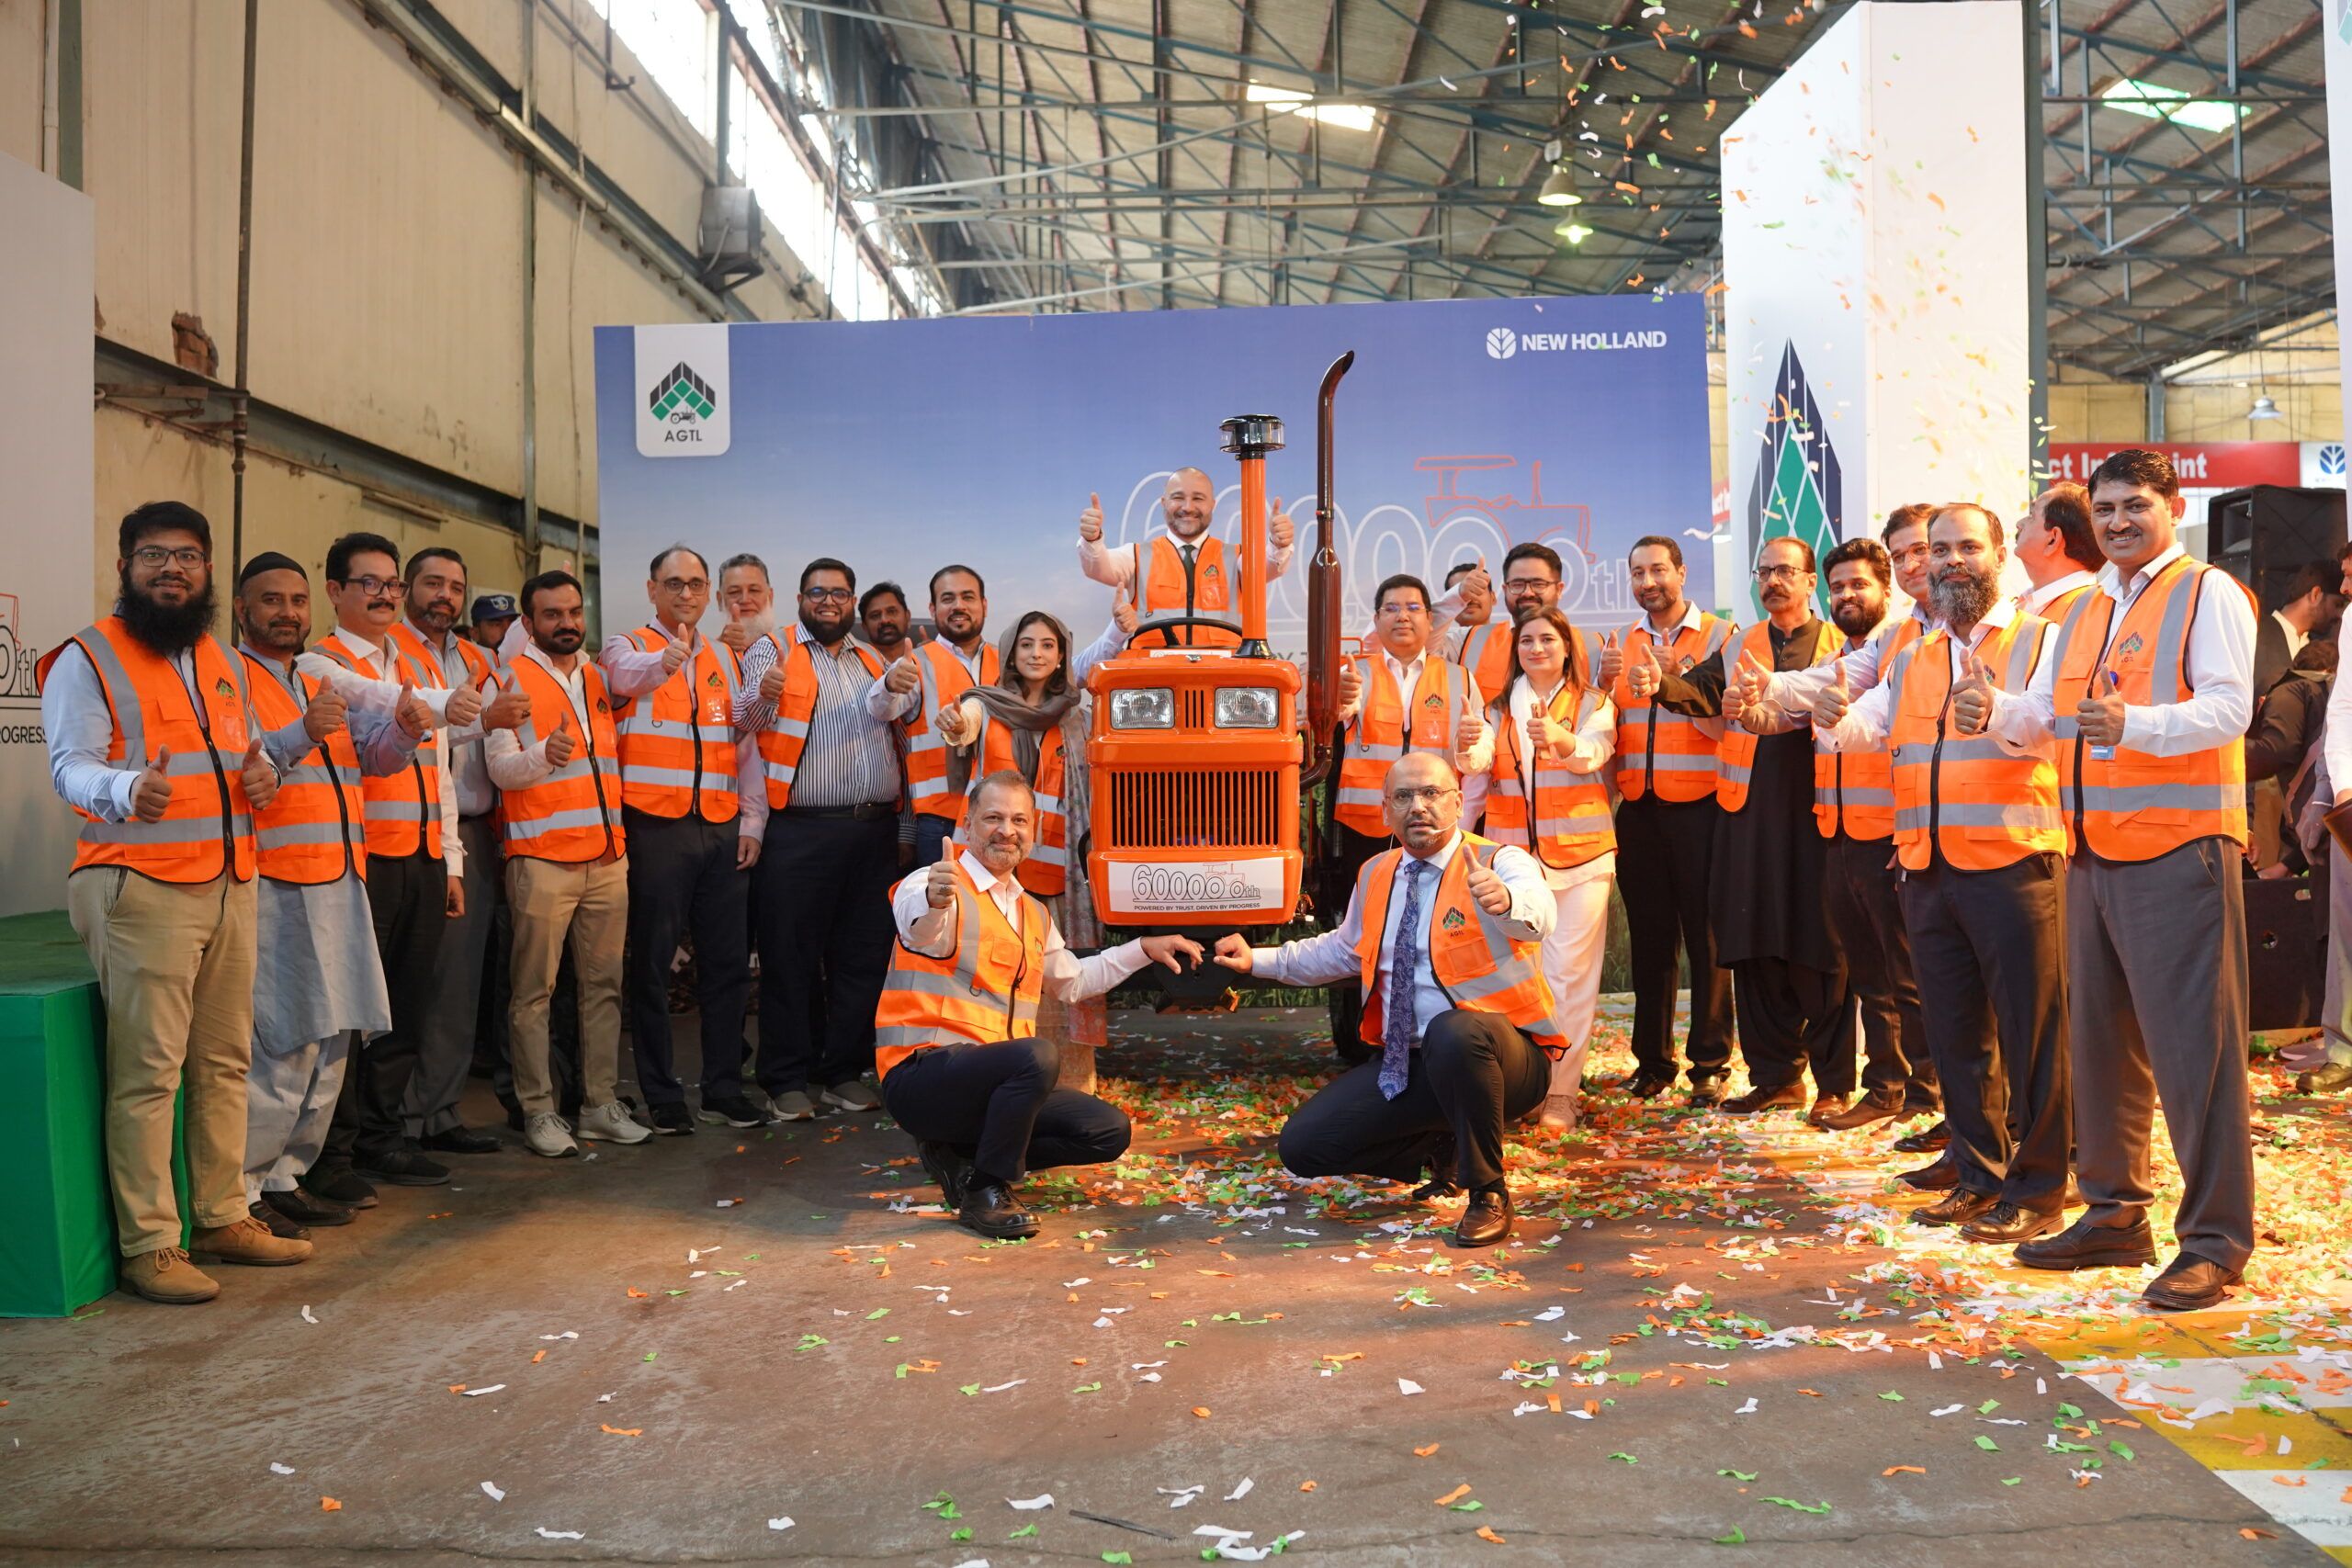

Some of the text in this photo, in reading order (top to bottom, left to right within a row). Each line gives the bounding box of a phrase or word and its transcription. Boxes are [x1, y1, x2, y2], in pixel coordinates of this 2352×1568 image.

[1521, 331, 1668, 351] NEW HOLLAND
[664, 429, 703, 442] AGTL
